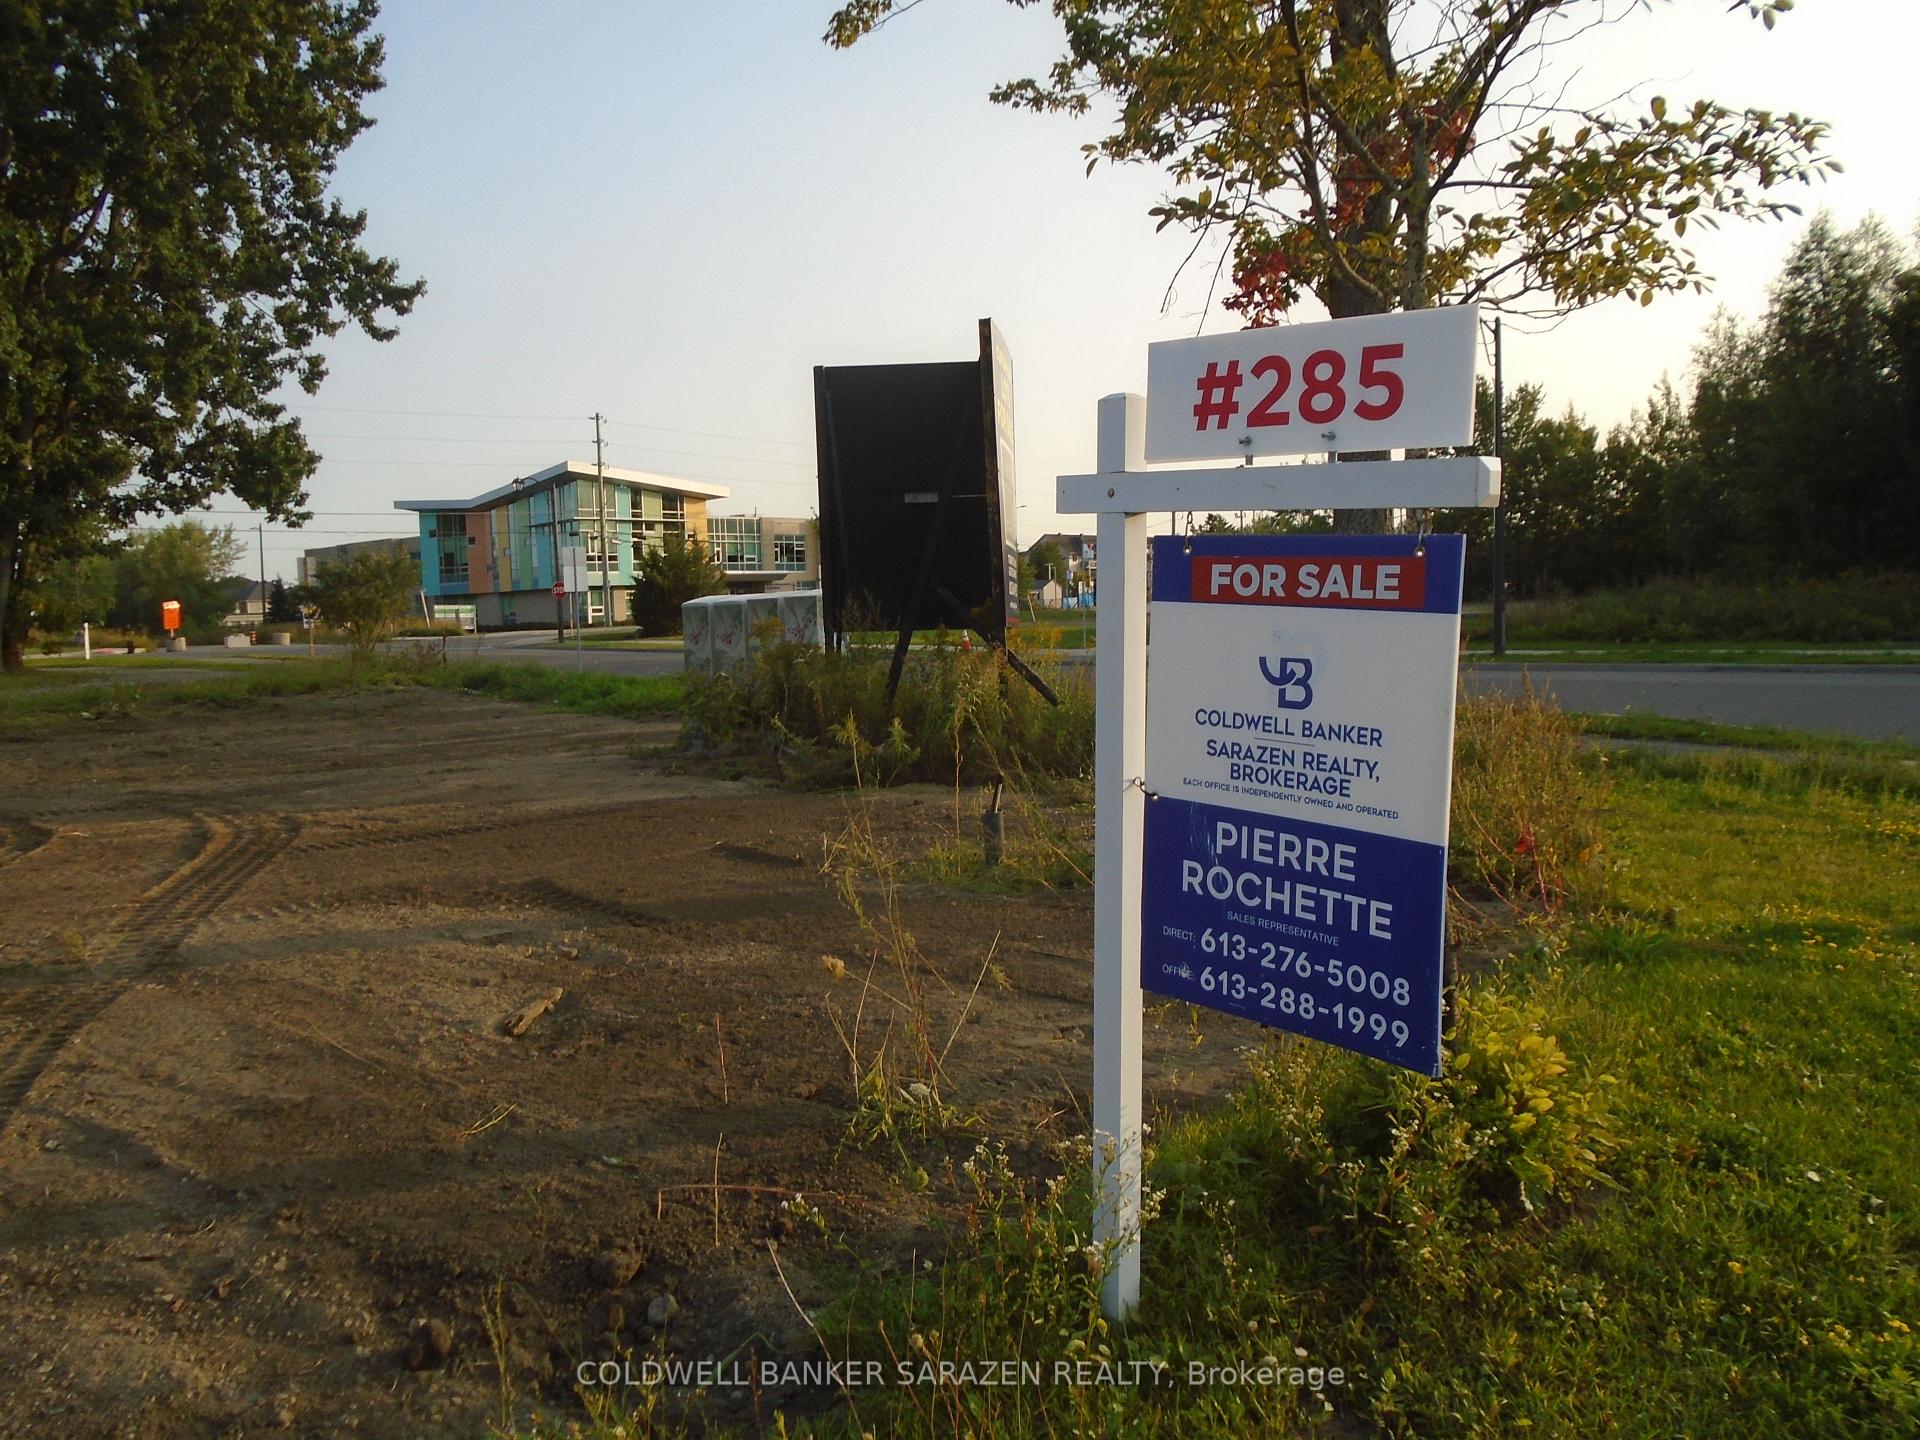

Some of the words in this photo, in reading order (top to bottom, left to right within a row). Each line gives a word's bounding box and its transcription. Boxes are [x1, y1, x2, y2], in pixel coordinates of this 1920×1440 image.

[1193, 343, 1405, 432] #285
[1210, 564, 1286, 597] FOR
[1297, 564, 1400, 600] SALE
[1195, 708, 1295, 737] COLDWELL
[1302, 720, 1383, 748] BANKER
[1206, 739, 1295, 768] SARAZEN
[1303, 751, 1380, 783] REALTY,
[1230, 763, 1351, 798] BROKERAGE
[1183, 777, 1203, 787] EACH
[1204, 781, 1231, 792] OFFICE
[1241, 787, 1302, 803] INDEPENDENTLY
[1304, 796, 1334, 809] OWNED
[1336, 803, 1354, 813] AND
[1356, 806, 1399, 820] OPERATED
[1216, 822, 1357, 882] PIERRE
[1182, 860, 1393, 940] ROCHETTE
[1226, 911, 1256, 926] SALES
[1258, 918, 1339, 947] REPRESENTATIVE
[1162, 925, 1196, 942] DIRECT:
[1201, 927, 1411, 1007] 613-276-5008
[1200, 966, 1410, 1048] 613-288-1999
